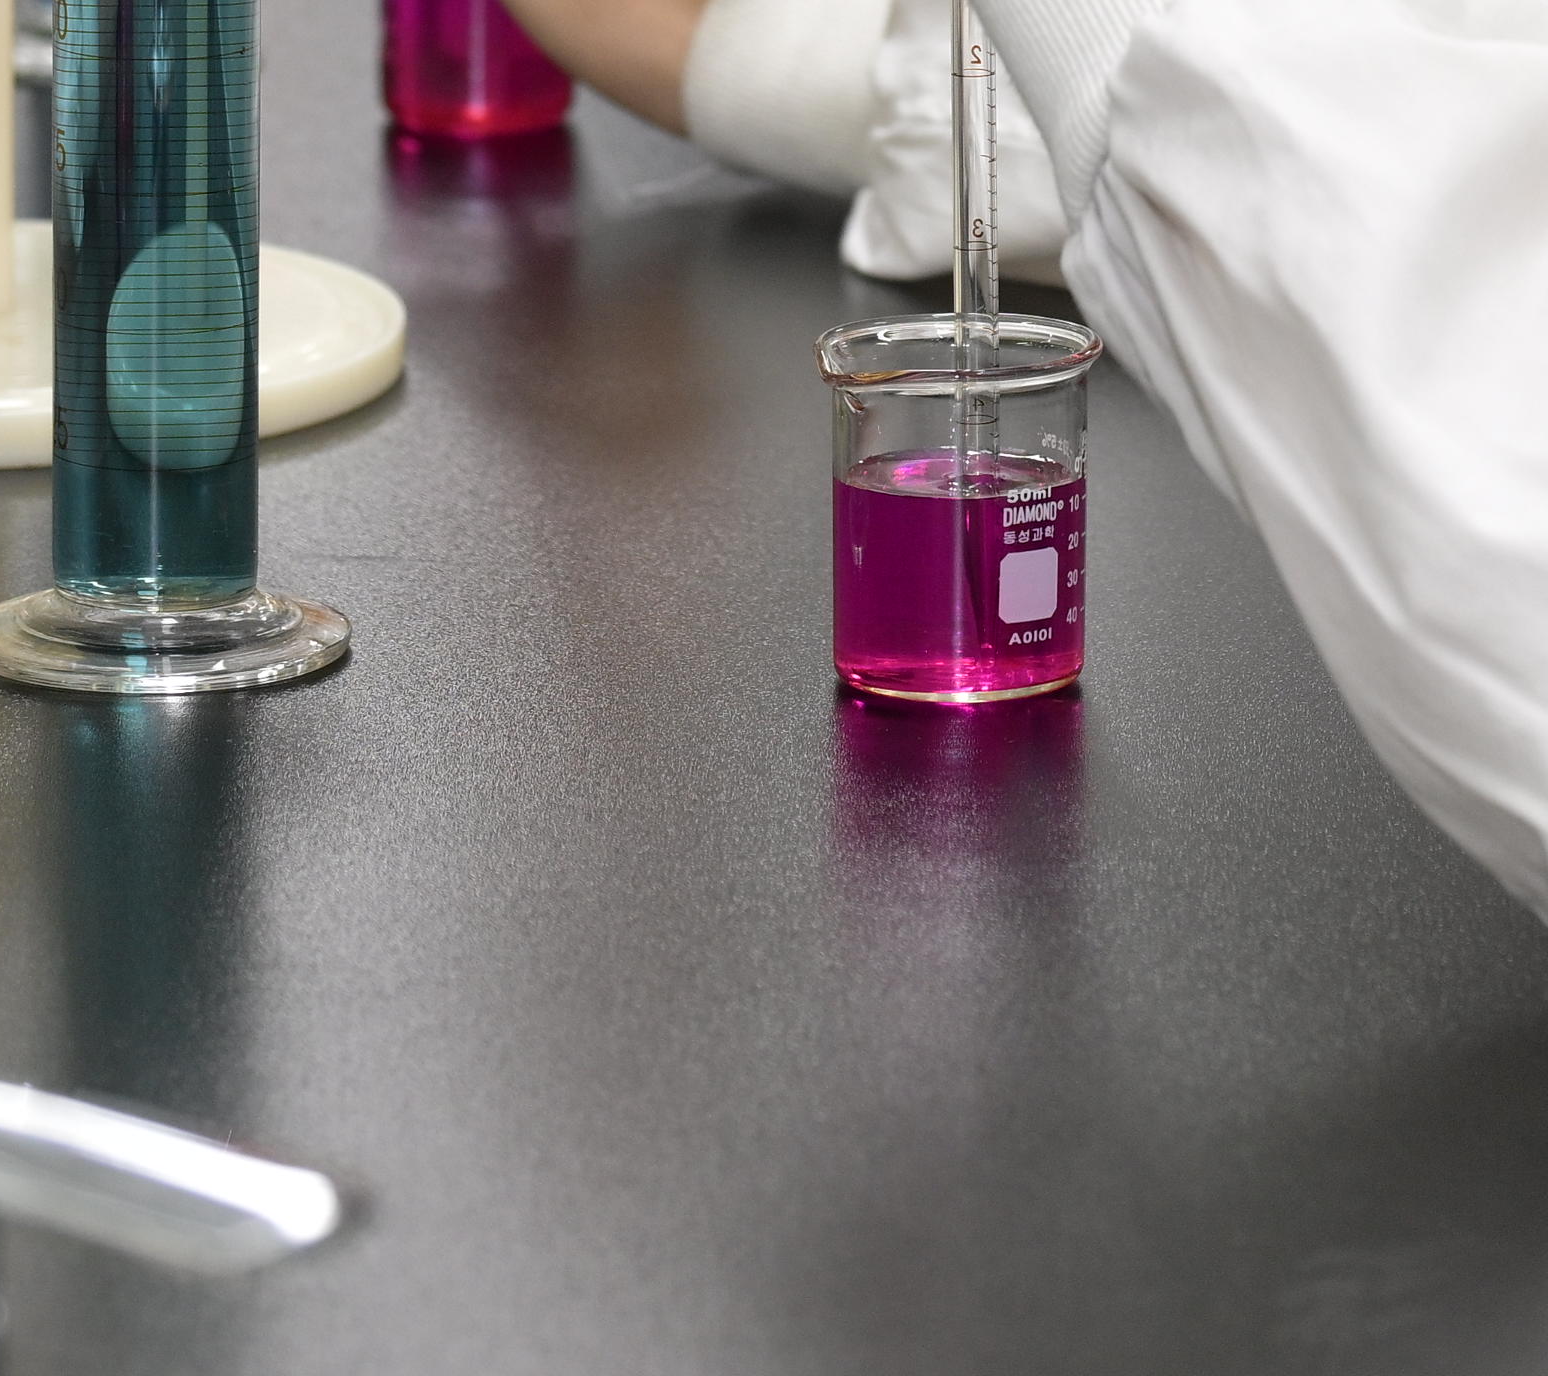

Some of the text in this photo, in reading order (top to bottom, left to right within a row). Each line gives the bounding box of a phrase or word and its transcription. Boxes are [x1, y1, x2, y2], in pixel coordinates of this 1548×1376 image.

[1068, 494, 1080, 512] 10
[1068, 531, 1079, 550] 20
[1066, 569, 1078, 588] 30
[1066, 607, 1078, 624] 40
